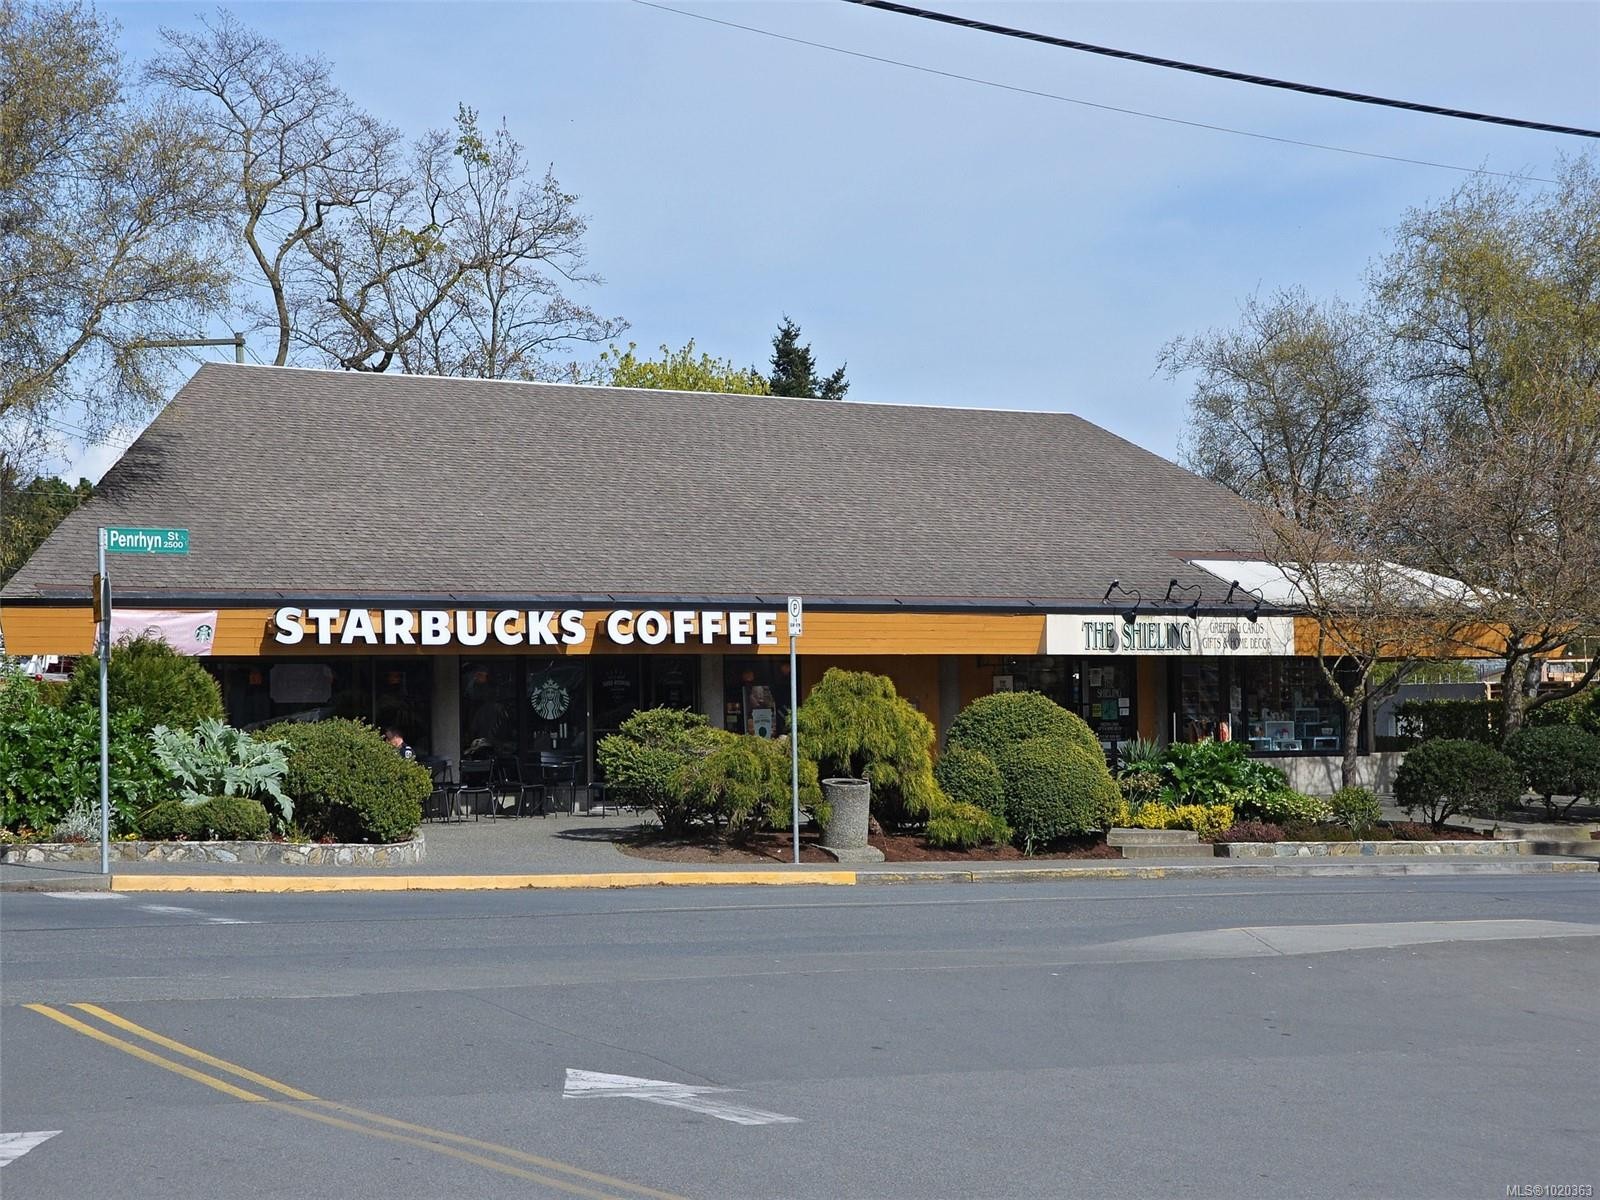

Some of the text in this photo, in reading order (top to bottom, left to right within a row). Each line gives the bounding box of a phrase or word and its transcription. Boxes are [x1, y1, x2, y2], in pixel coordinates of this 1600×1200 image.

[110, 530, 161, 551] Penrhyn
[167, 531, 179, 541] St
[274, 606, 586, 647] STARBUCKS
[607, 608, 778, 646] COFFEE
[1209, 623, 1265, 634] GREETING CARDS
[1082, 621, 1192, 652] THE SHIELING
[1202, 637, 1221, 649] GIFTS
[1249, 638, 1271, 649] DECOR
